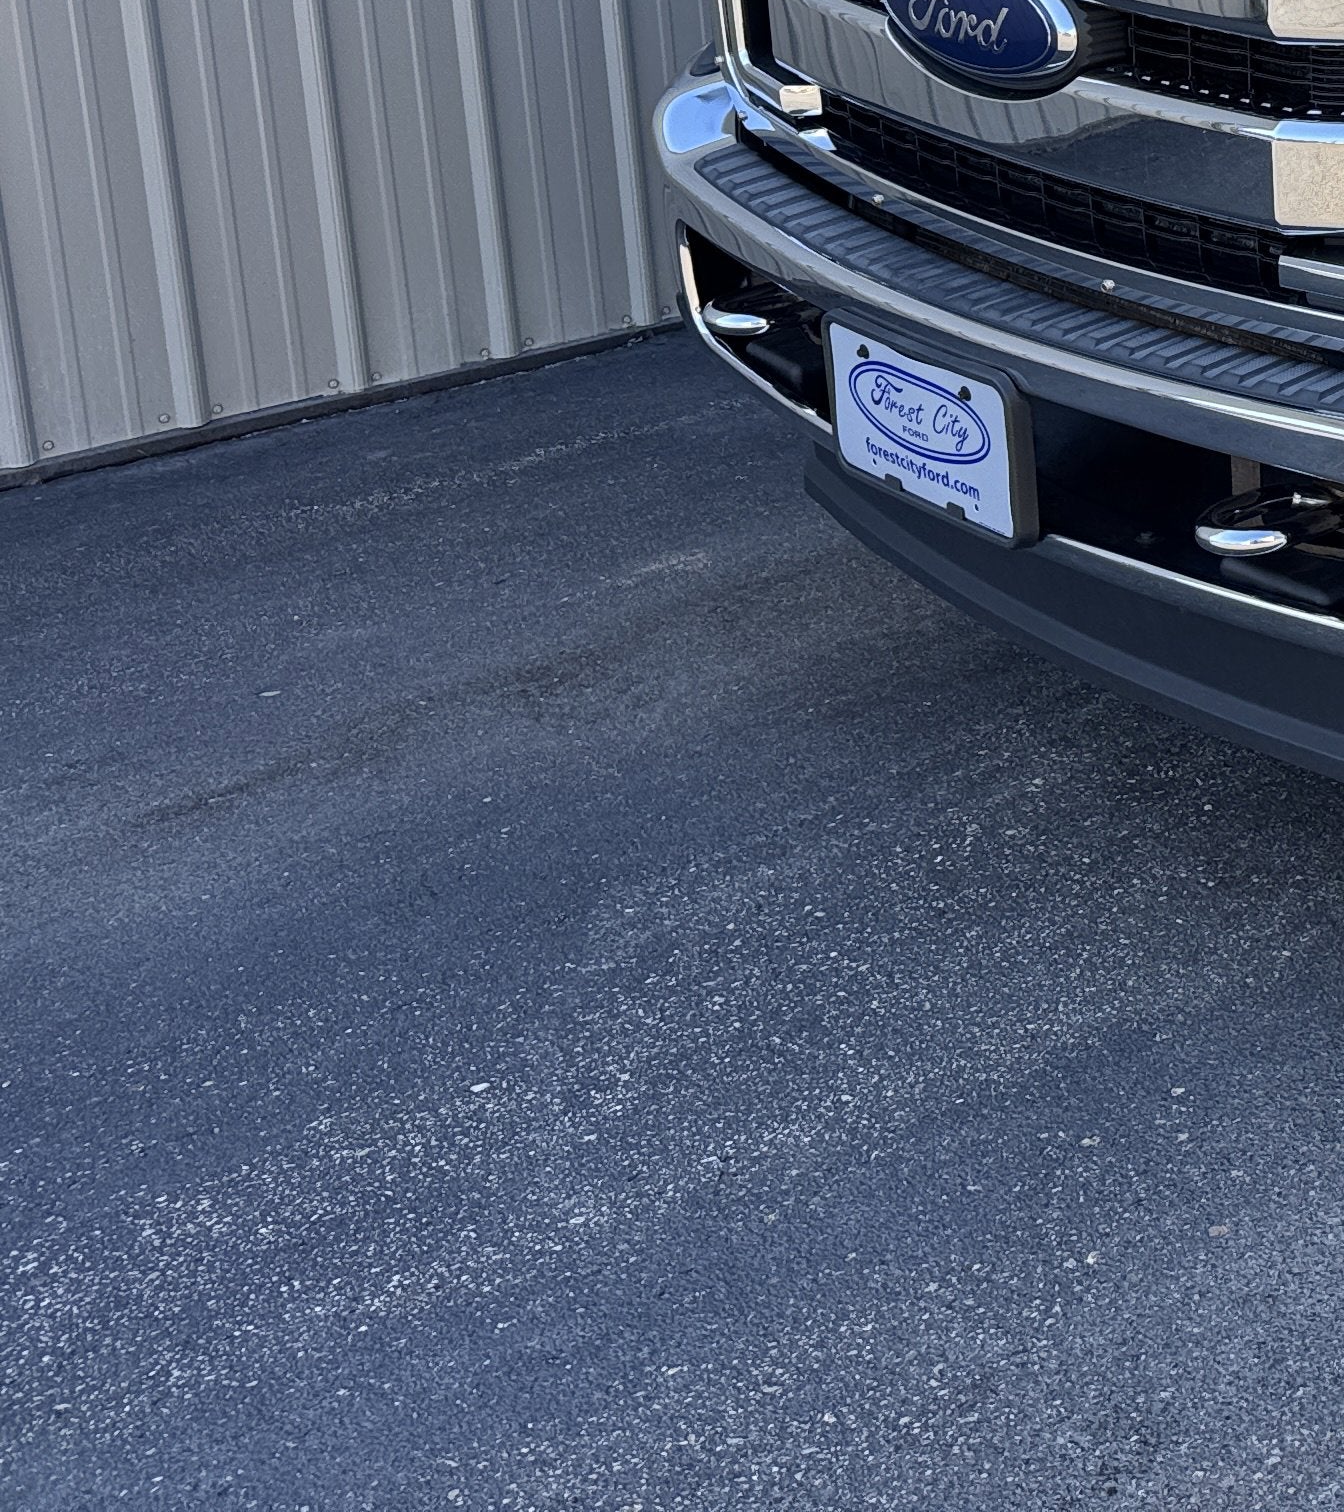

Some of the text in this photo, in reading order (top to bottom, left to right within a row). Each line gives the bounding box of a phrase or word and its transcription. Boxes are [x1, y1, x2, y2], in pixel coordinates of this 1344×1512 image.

[871, 374, 970, 453] Forest City
[902, 425, 929, 443] FORD
[866, 436, 981, 502] forestcityford.com
